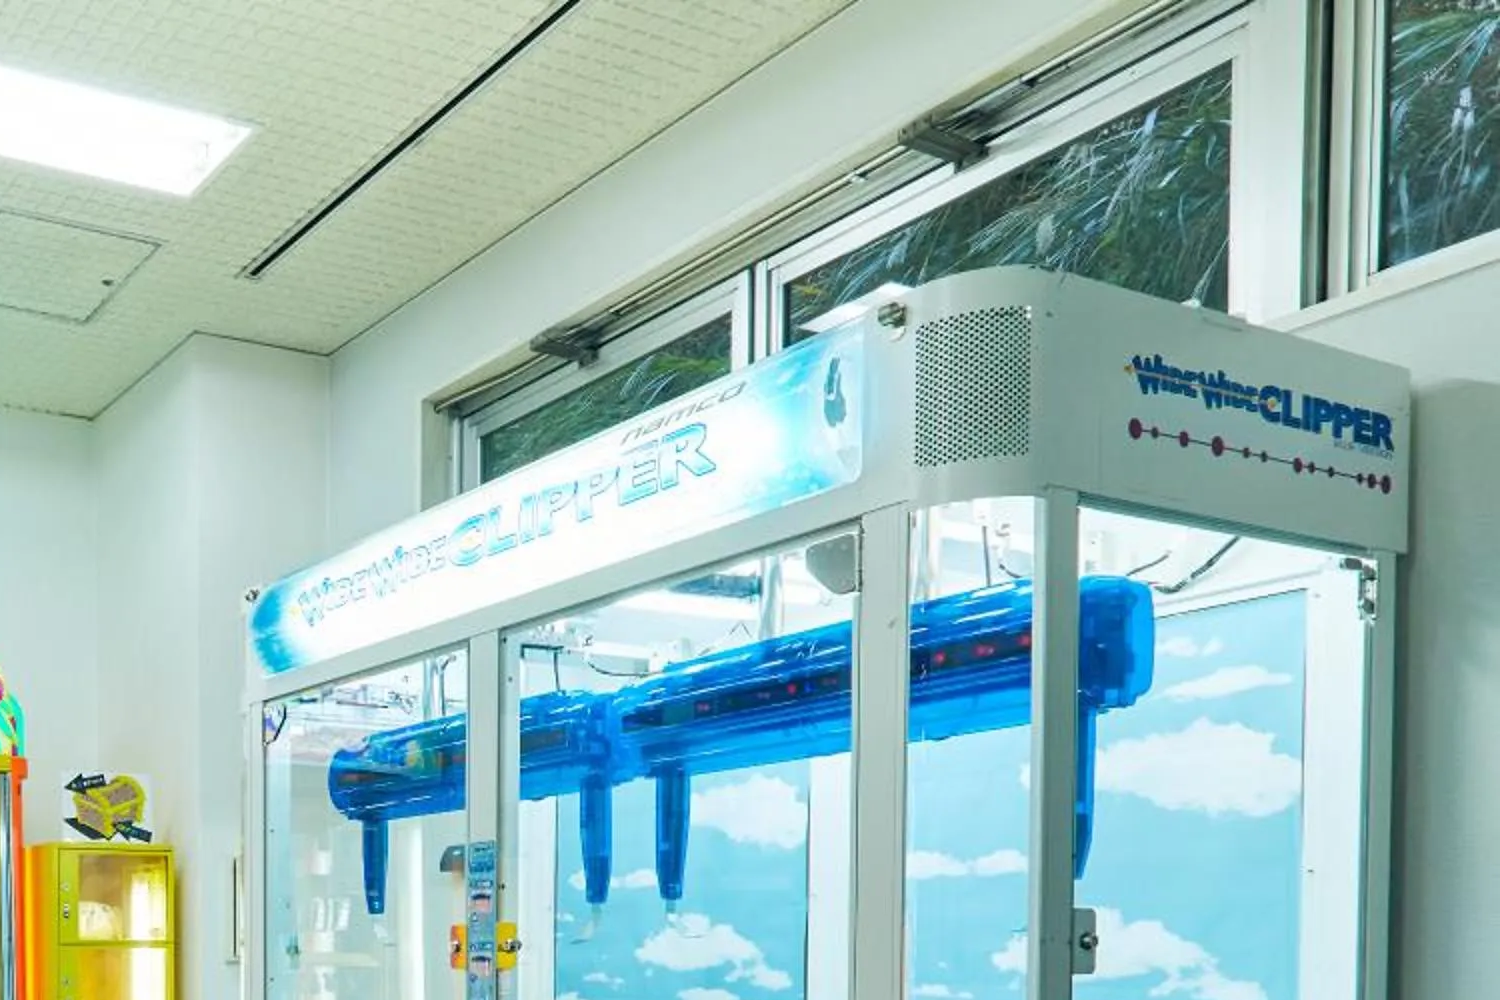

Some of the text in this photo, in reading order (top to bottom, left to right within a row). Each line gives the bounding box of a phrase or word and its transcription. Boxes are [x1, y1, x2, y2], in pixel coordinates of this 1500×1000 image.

[620, 380, 748, 446] namco
[1258, 384, 1396, 452] CLIPPER
[448, 421, 717, 568] CLIPPER
